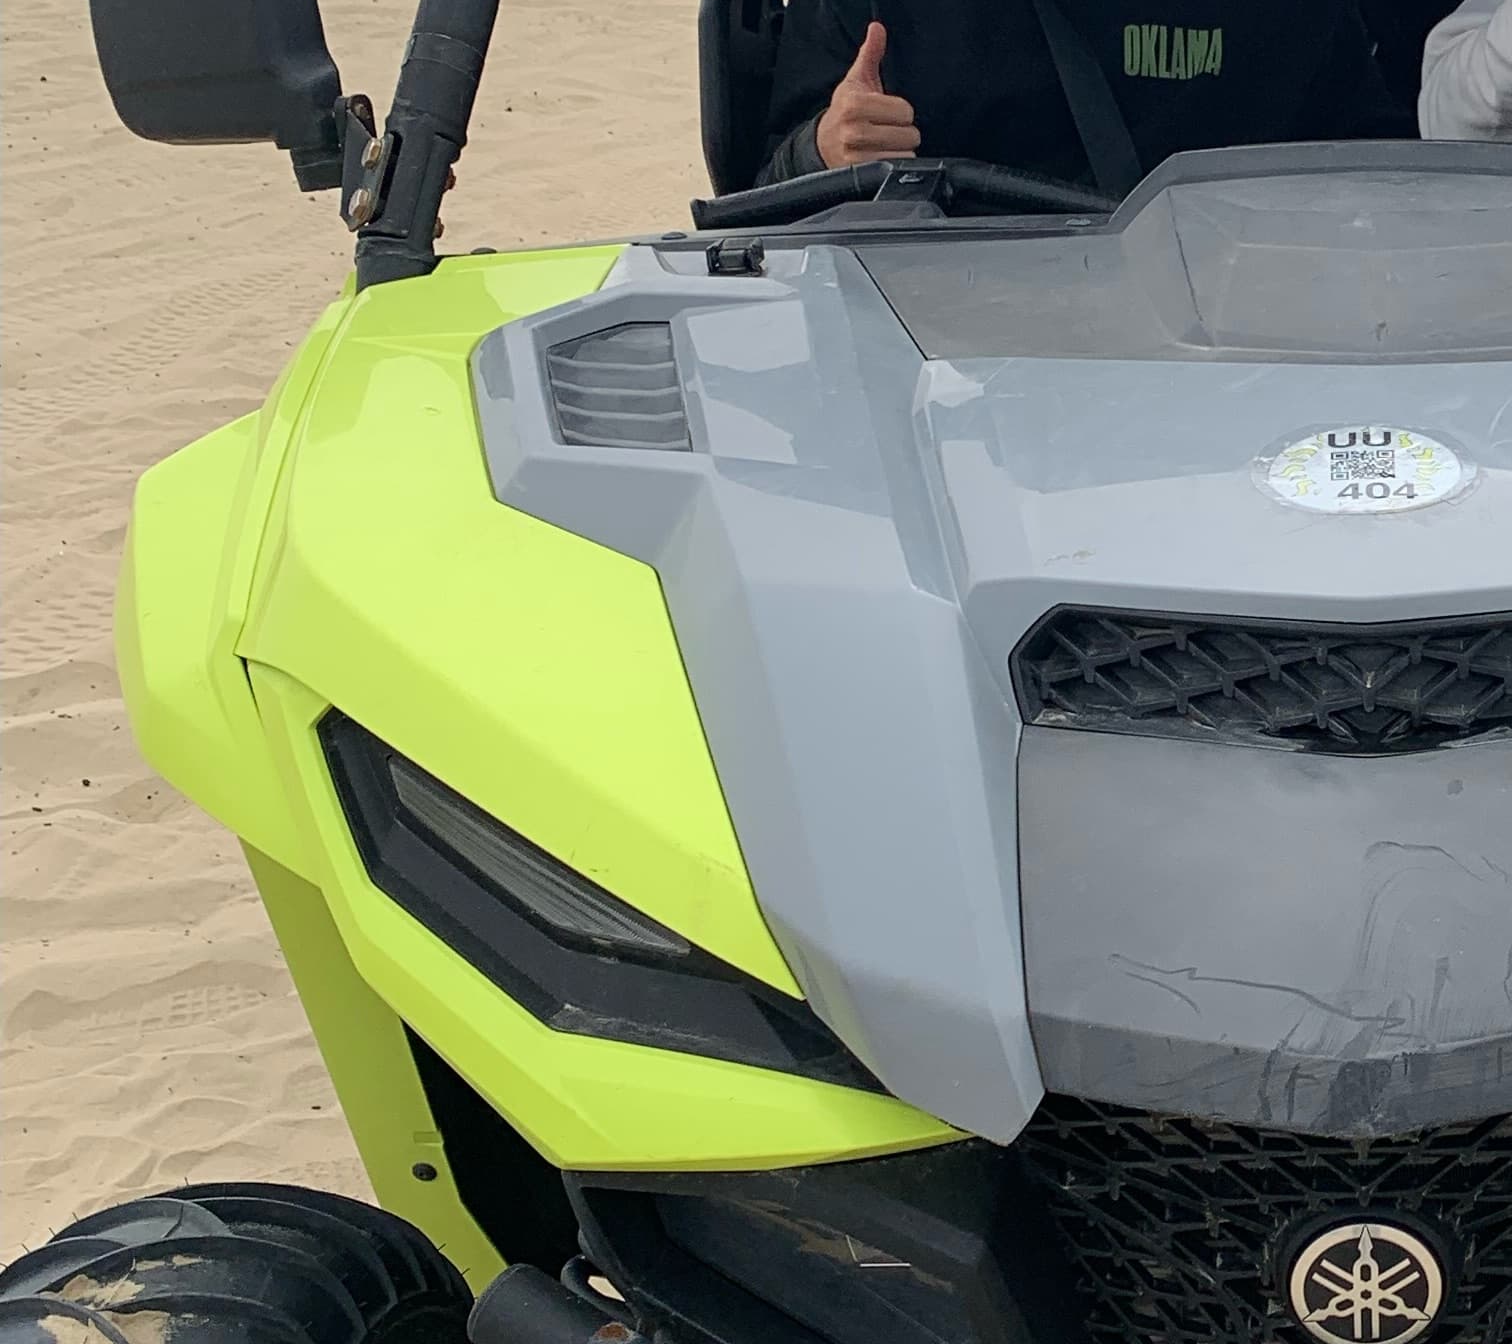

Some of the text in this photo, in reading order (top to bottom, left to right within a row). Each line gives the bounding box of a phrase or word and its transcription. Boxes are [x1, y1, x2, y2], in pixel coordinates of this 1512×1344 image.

[1123, 23, 1223, 80] OKLAMA
[1327, 431, 1392, 448] UU
[1337, 482, 1419, 500] 404
